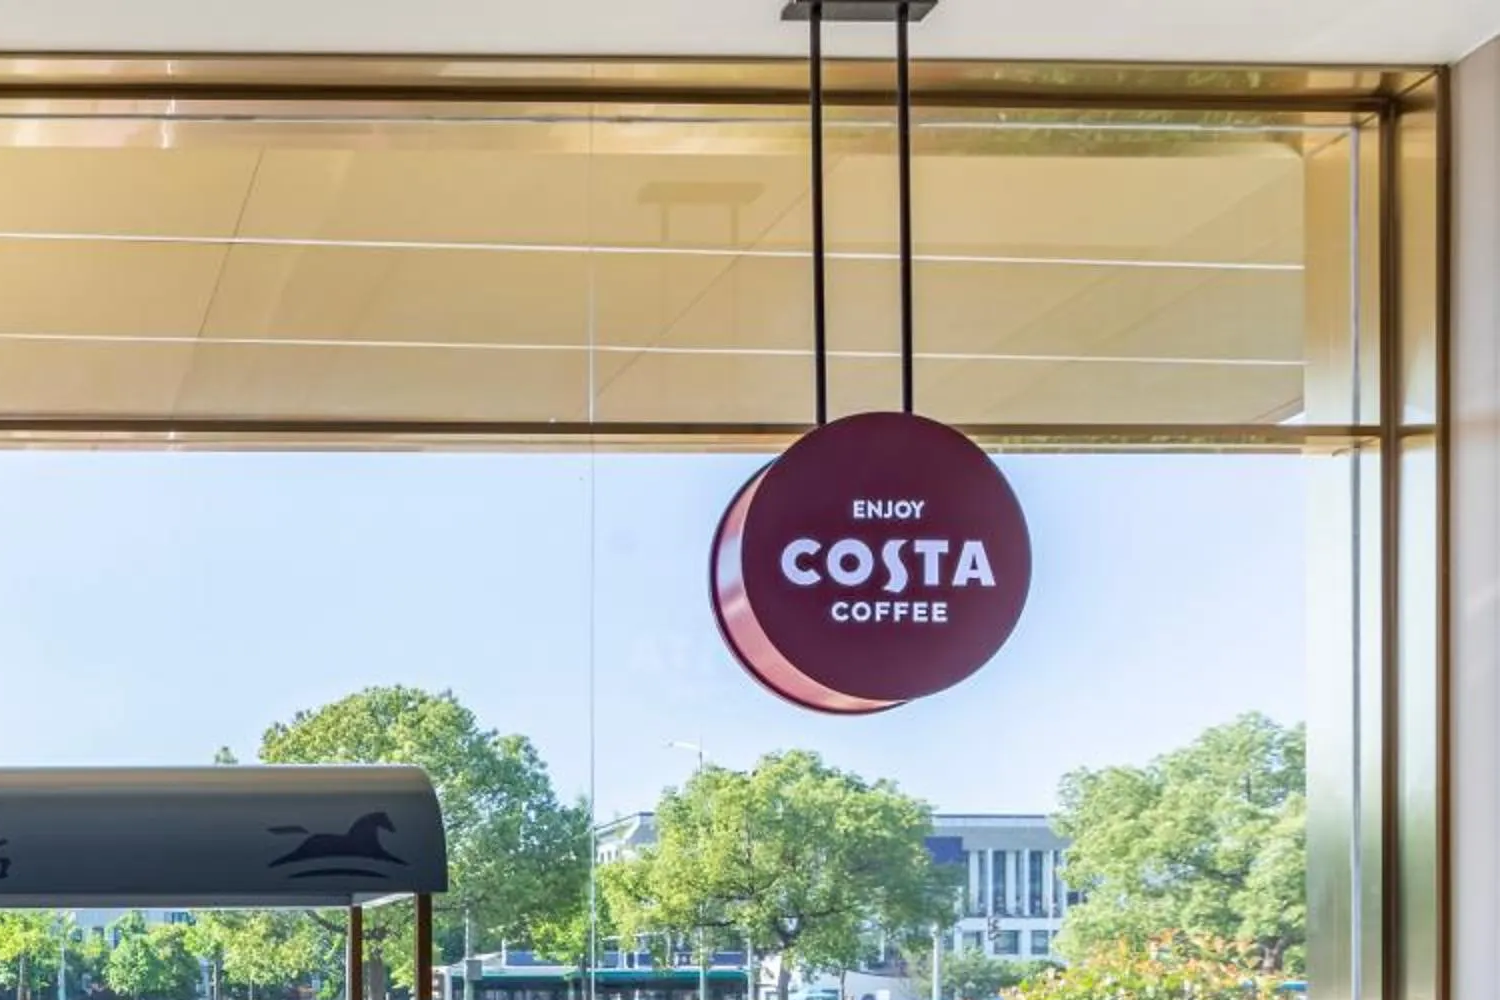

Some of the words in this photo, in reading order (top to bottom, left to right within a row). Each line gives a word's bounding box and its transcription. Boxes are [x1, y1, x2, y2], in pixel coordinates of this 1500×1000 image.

[853, 499, 925, 519] ENJOY
[781, 538, 996, 593] COSTA
[831, 601, 949, 622] COFFEE
